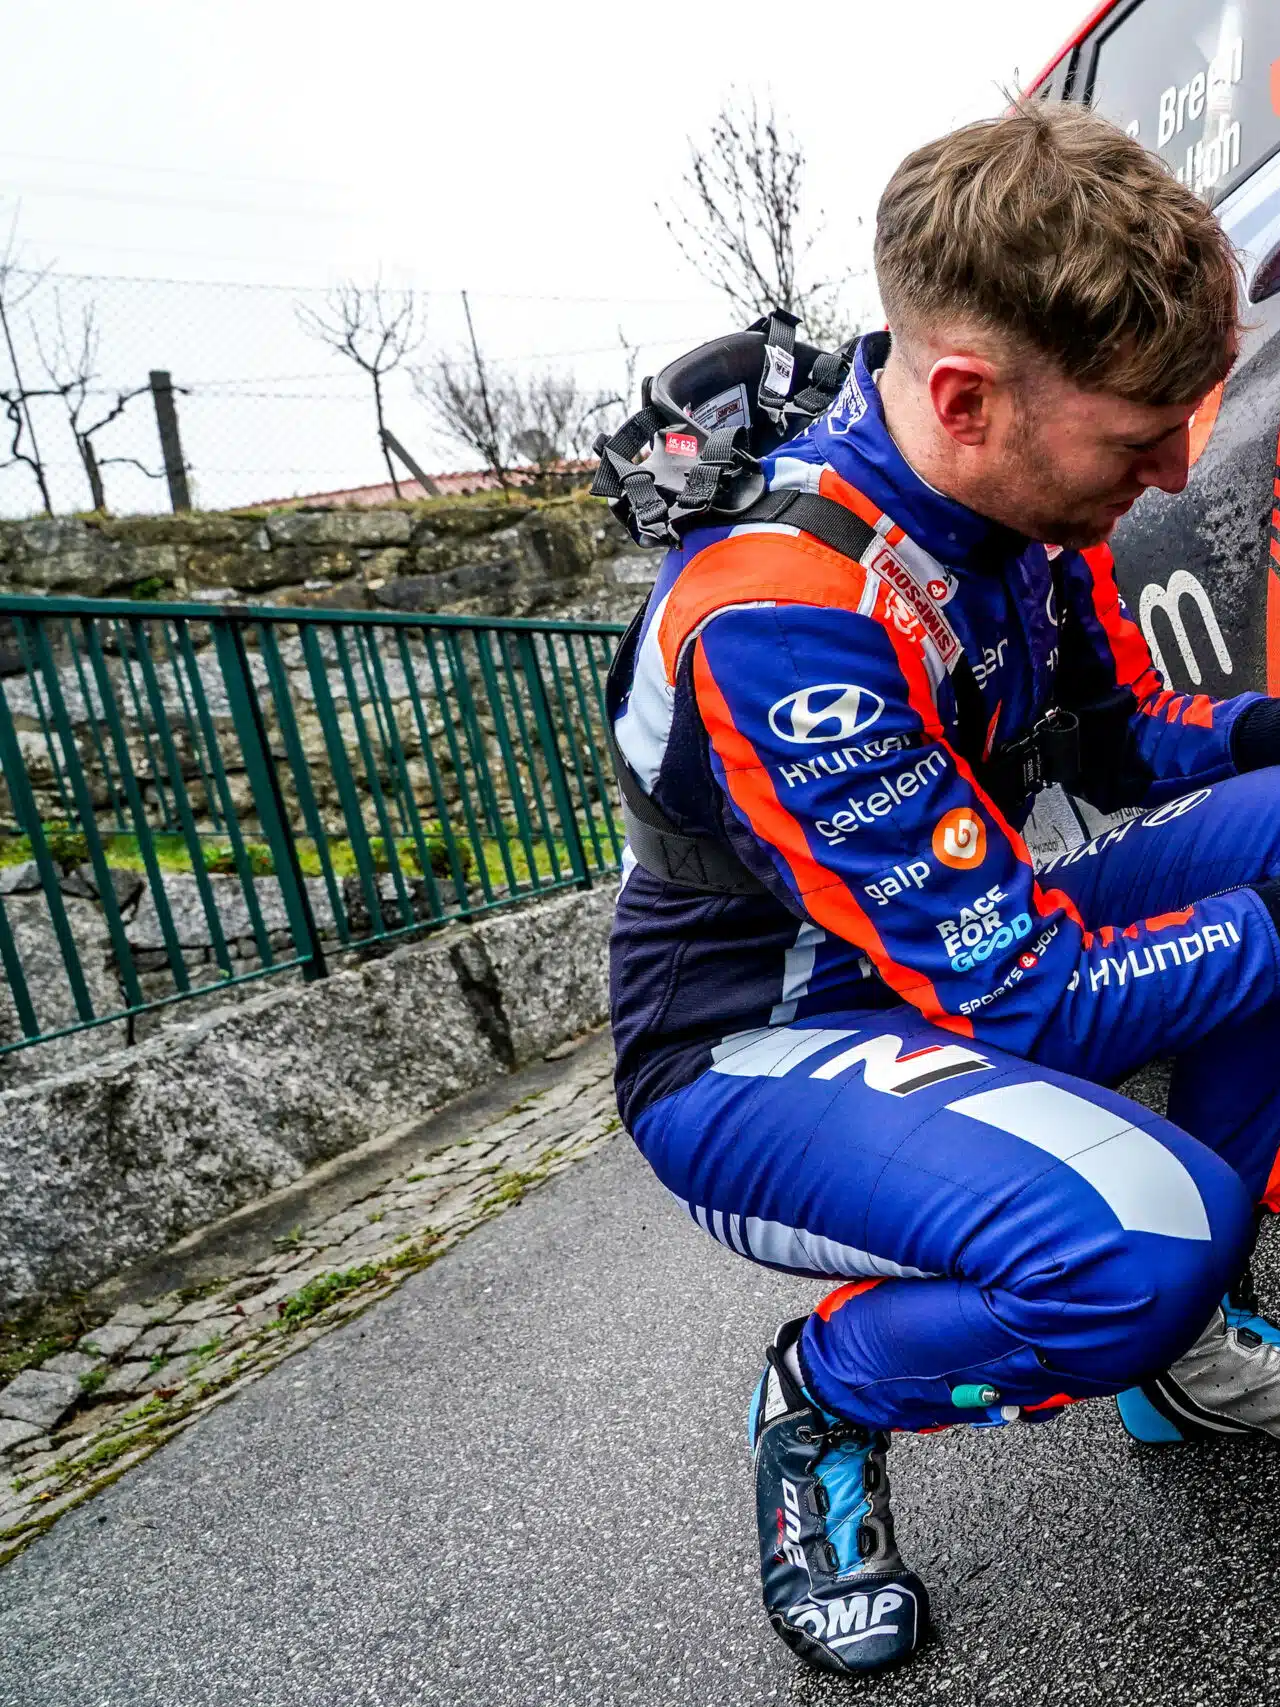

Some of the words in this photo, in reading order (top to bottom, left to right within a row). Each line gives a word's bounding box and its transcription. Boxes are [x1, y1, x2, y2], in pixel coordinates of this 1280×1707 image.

[680, 440, 697, 453] 625
[880, 555, 953, 659] SIMPSON
[864, 861, 931, 906] galp
[936, 884, 1008, 939] RACE
[944, 911, 1004, 958] FOR
[951, 913, 1032, 972] GOOD
[1089, 921, 1241, 992] HYUNDAI
[793, 1591, 903, 1639] OMP
